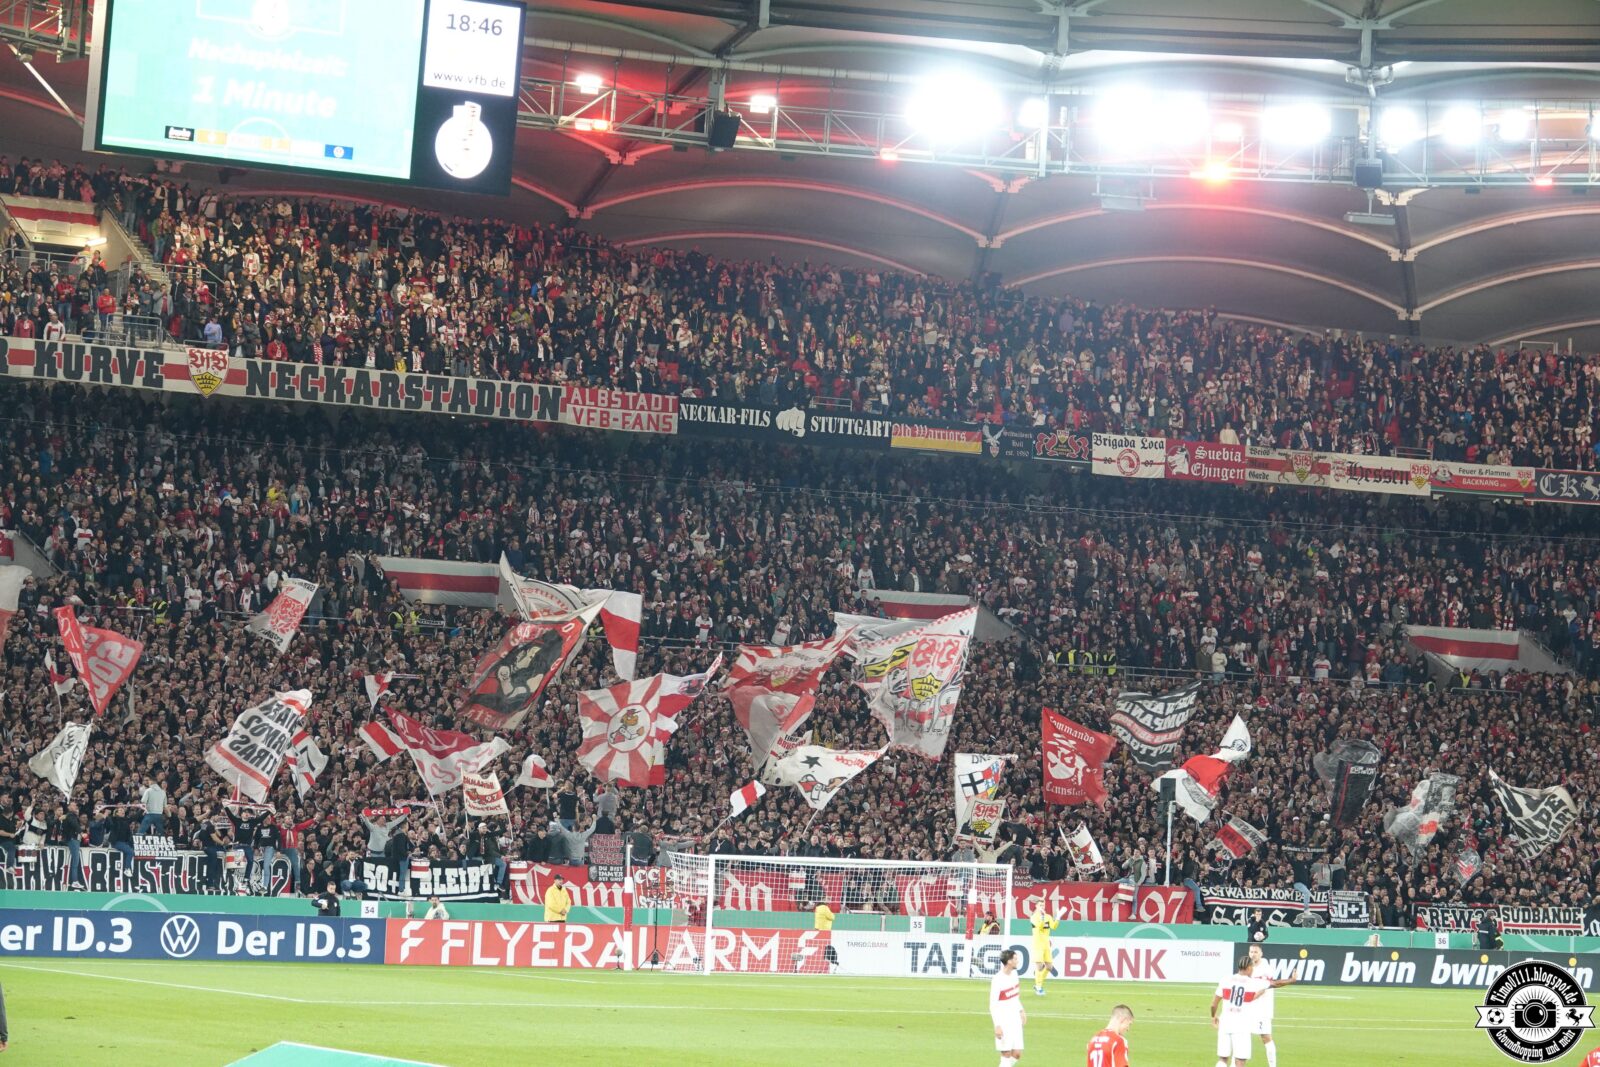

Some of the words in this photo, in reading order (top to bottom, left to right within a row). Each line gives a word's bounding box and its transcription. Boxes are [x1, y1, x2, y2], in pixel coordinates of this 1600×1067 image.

[445, 13, 503, 37] 18:46
[433, 70, 506, 89] www.vfb.de
[224, 78, 337, 118] Minute
[34, 341, 164, 388] KURVE
[246, 360, 563, 421] NECKARSTADION
[570, 388, 676, 412] ALBSTADT
[572, 407, 674, 431] VFB-FANS
[680, 403, 771, 427] NECKAR-FILS
[810, 415, 892, 438] STUTTGART
[1093, 434, 1136, 450] Brigada
[1140, 438, 1164, 450] Loca
[1195, 446, 1242, 463] Suebia
[1347, 461, 1410, 486] Hessen
[1458, 467, 1476, 476] Feuer
[1478, 468, 1484, 476] &
[1485, 469, 1511, 477] Flamme
[1462, 478, 1499, 487] BACKNANG
[133, 835, 174, 845] ULTRAS
[1201, 886, 1270, 899] SCHWABEN
[364, 905, 375, 915] 34
[1138, 890, 1187, 922] 97
[1418, 907, 1473, 929] CREW
[52, 916, 133, 952] ID.3
[216, 920, 286, 956] Der
[295, 923, 371, 958] ID.3
[1340, 951, 1416, 984] bwin
[1431, 953, 1507, 985] bwin
[1230, 985, 1245, 1007] 18
